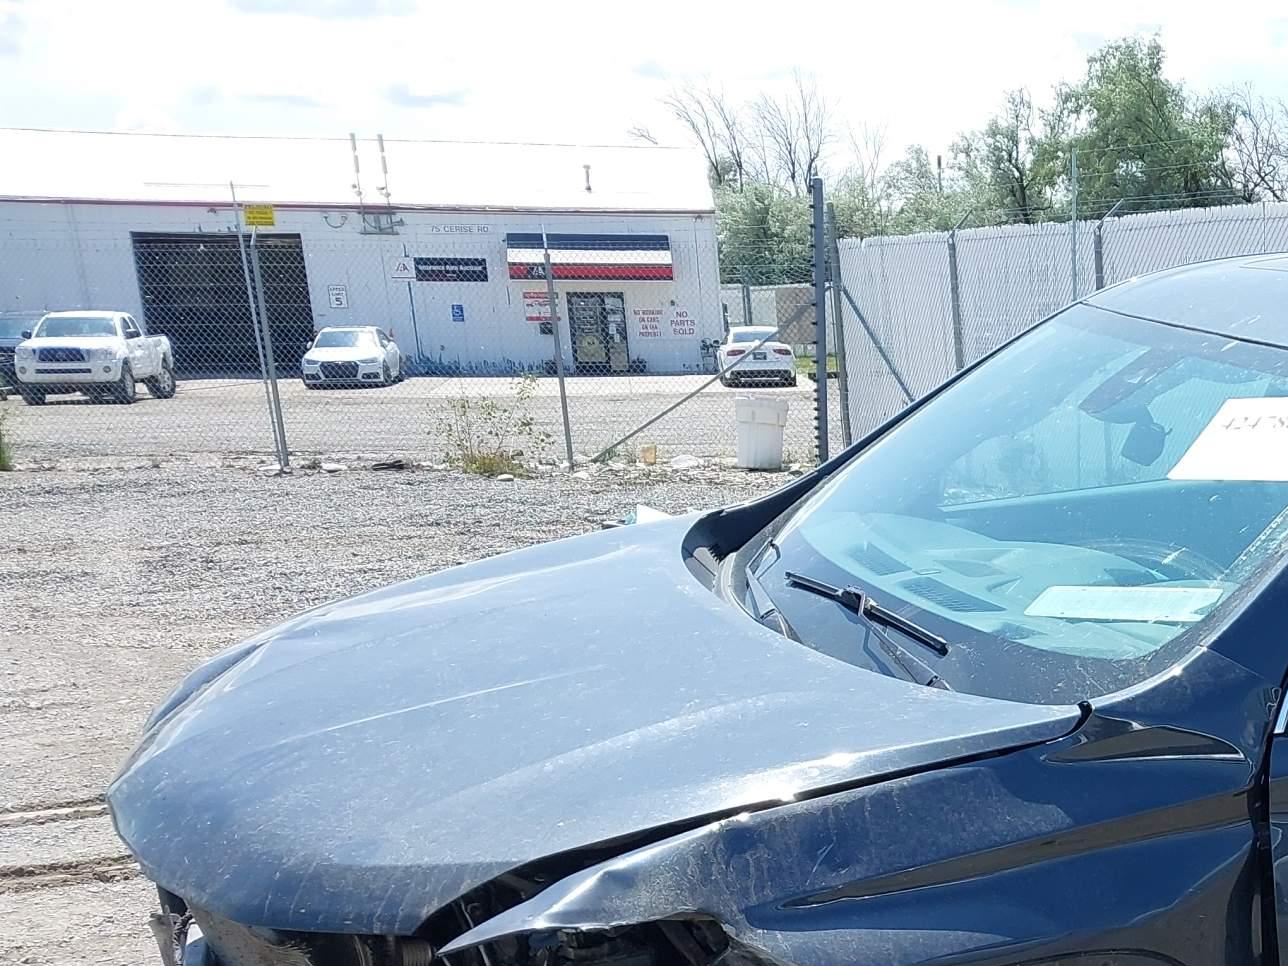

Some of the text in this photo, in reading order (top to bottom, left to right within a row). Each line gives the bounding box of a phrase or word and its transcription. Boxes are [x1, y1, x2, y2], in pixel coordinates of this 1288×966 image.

[443, 225, 473, 233] CERISE
[335, 297, 343, 306] 5
[671, 319, 696, 327] PARTS
